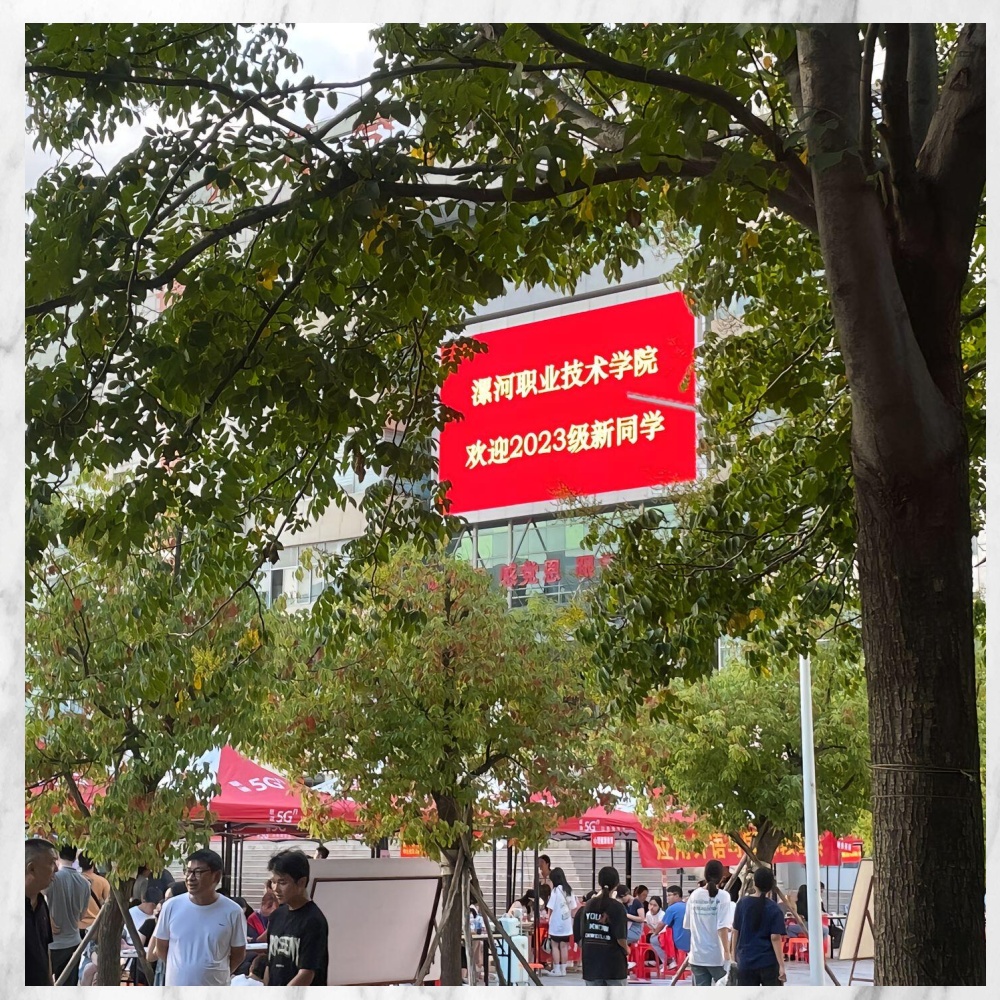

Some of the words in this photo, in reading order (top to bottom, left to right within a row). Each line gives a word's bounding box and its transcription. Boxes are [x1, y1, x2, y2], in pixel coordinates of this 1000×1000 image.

[471, 345, 659, 407] 漯河职业技术学院
[464, 410, 666, 469] 欢迎2023级新同学
